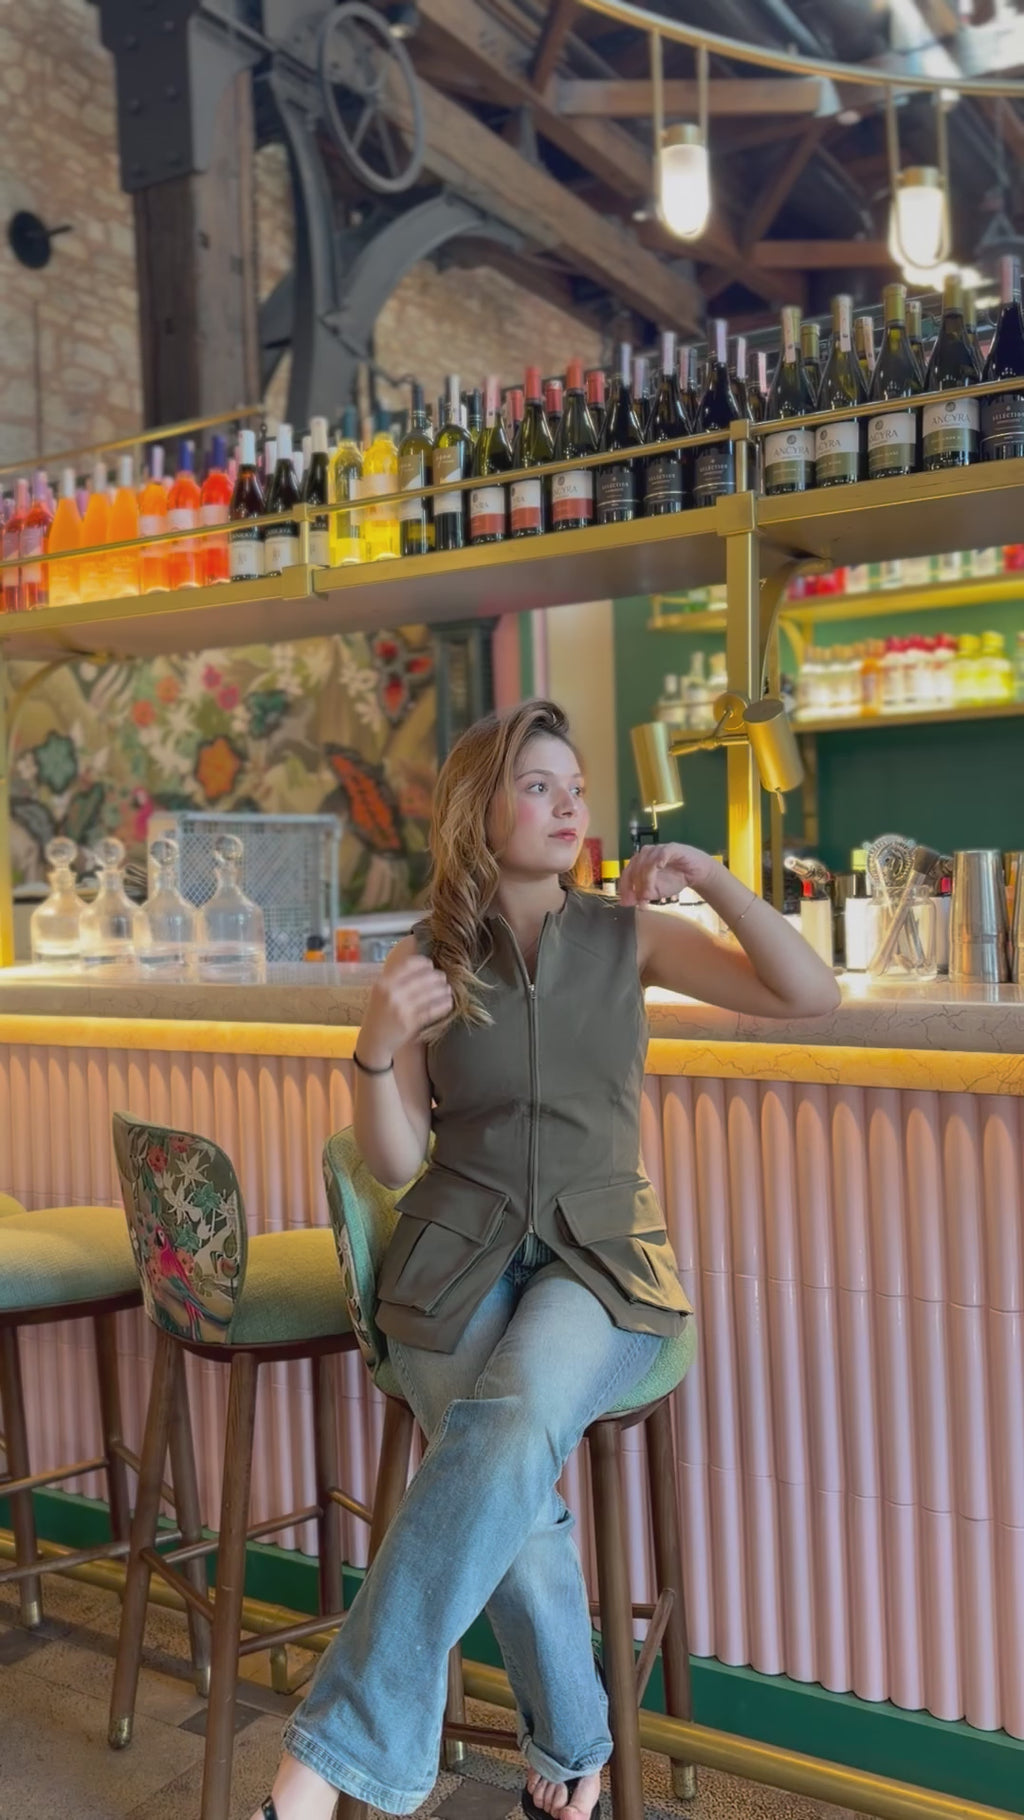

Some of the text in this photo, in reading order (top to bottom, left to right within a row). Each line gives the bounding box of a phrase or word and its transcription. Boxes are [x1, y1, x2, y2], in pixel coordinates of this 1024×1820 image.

[931, 413, 971, 425] ANCYRA
[774, 446, 810, 457] ANCYRA
[700, 463, 728, 472] SELECTION
[648, 473, 676, 481] SELECTION
[602, 482, 629, 490] SELECTION
